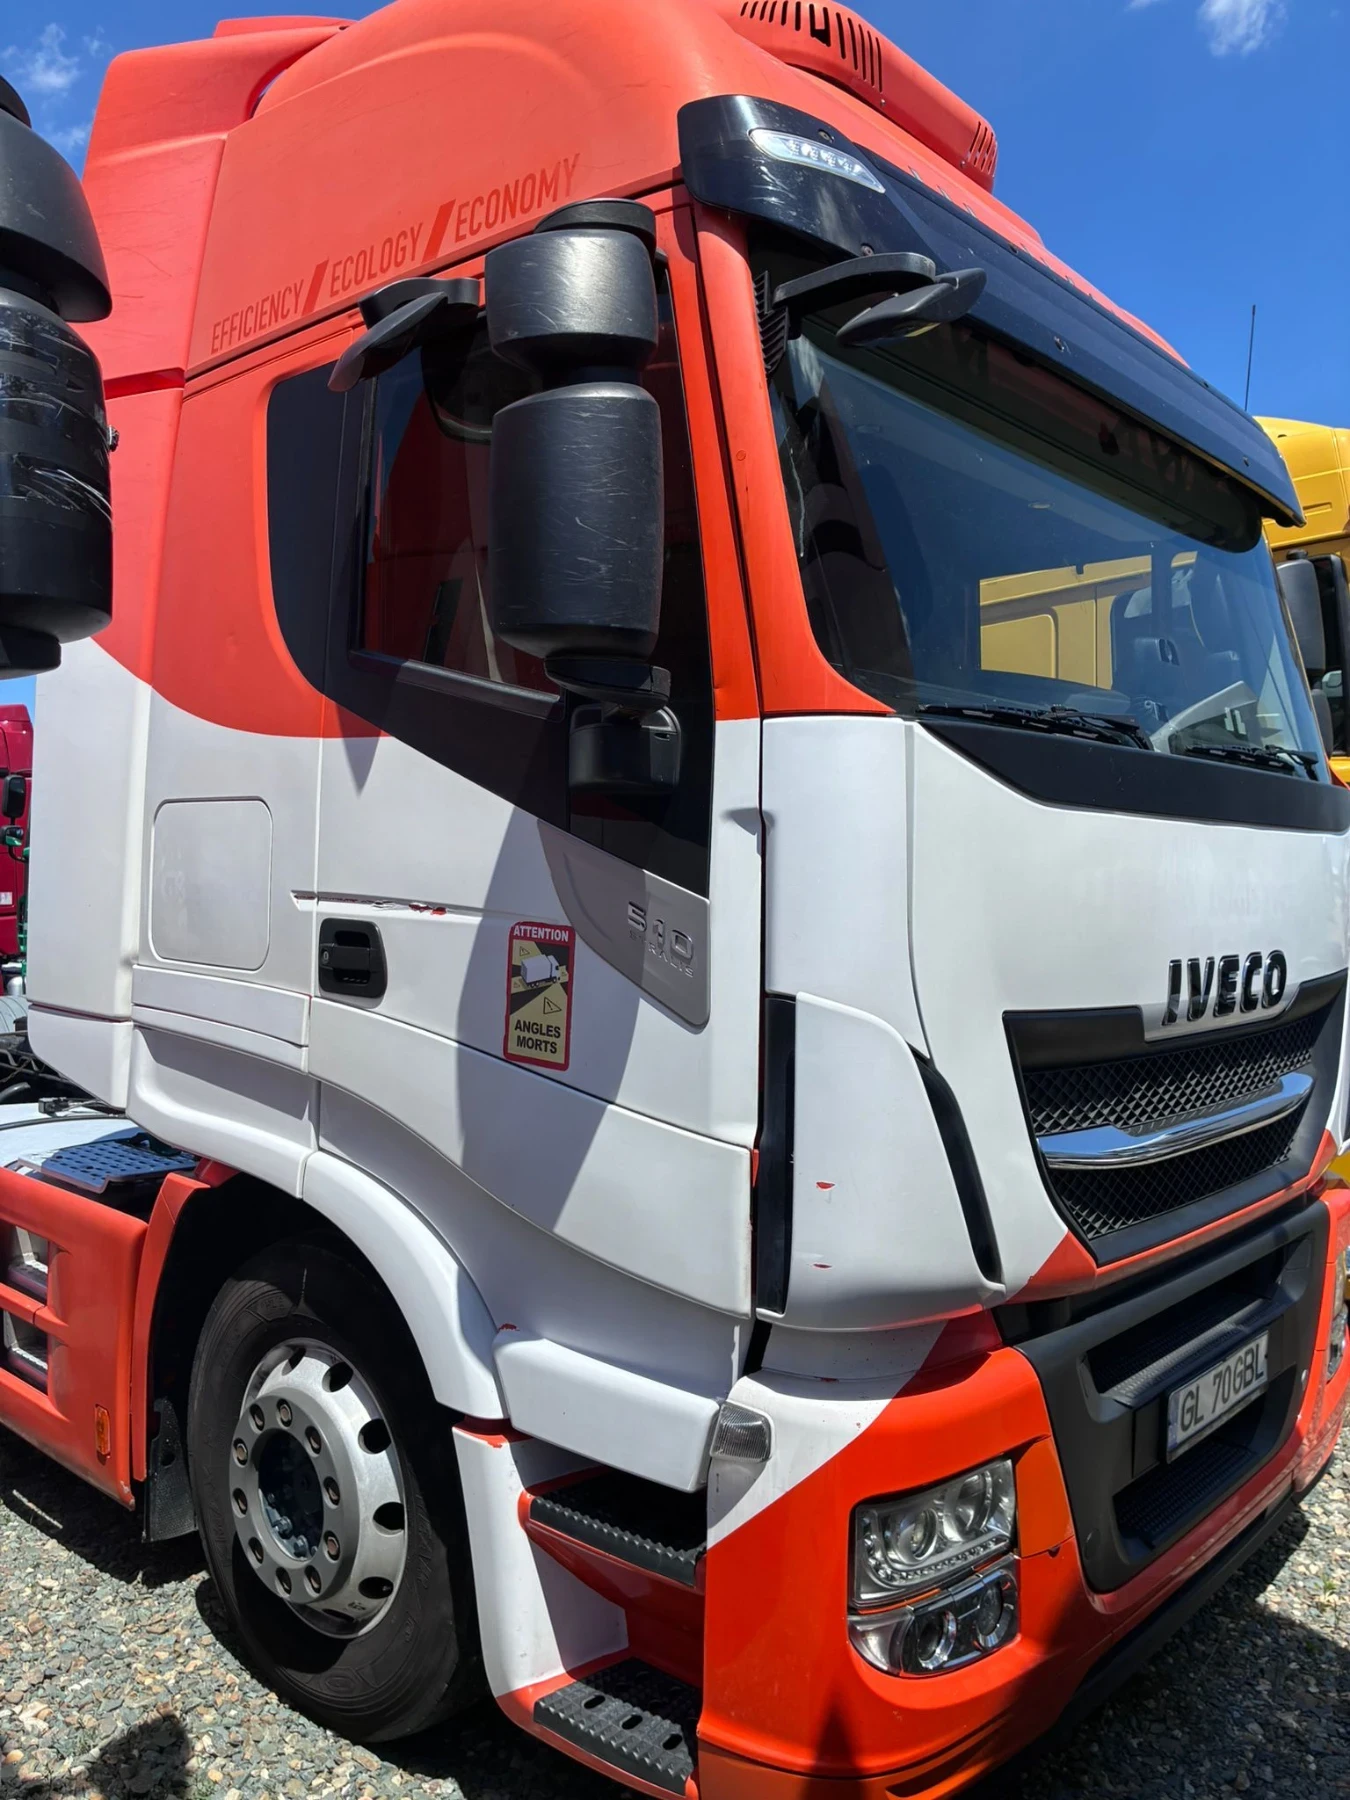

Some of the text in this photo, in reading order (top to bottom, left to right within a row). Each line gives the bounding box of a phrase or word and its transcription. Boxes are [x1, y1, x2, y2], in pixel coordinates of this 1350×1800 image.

[211, 153, 581, 354] EFFICIENCY ECOLOGY ECONOMY
[513, 925, 570, 942] ATTENTION
[627, 901, 694, 965] 510
[1161, 949, 1287, 1026] IVECO
[514, 1019, 561, 1039] ANGLES
[516, 1035, 558, 1054] MORTS
